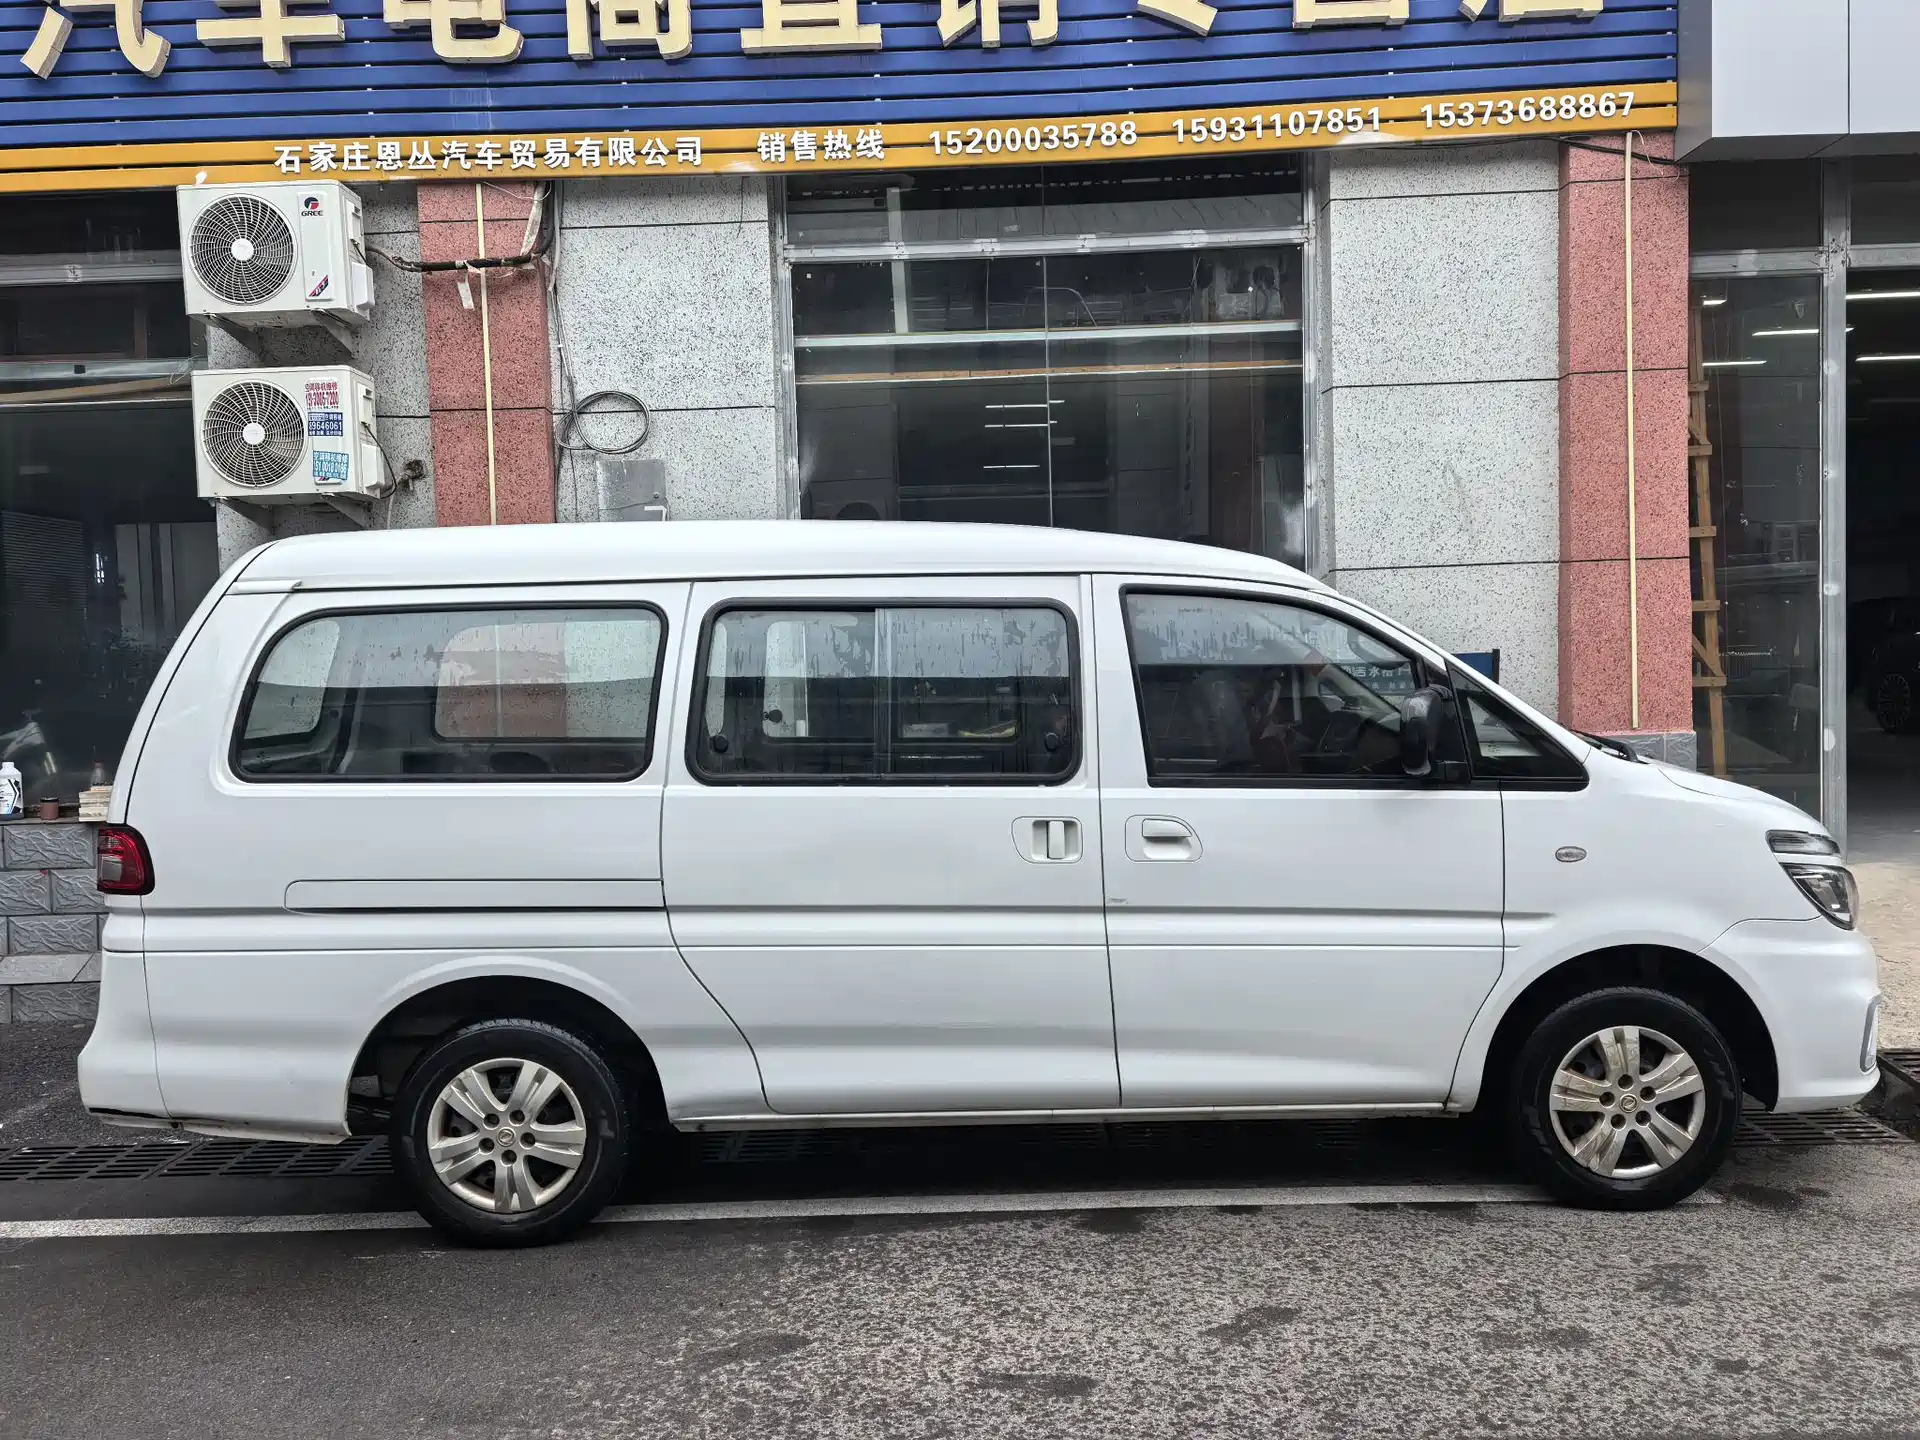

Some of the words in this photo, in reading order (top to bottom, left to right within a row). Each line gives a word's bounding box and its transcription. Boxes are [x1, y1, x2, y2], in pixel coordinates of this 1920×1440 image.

[274, 136, 703, 174] 石家庄恩丛汽车贸易有限公司
[756, 128, 885, 163] 销售热线
[929, 121, 1138, 155] 15200035788
[1171, 106, 1382, 143] 15931107851
[1419, 91, 1636, 129] 15373688867
